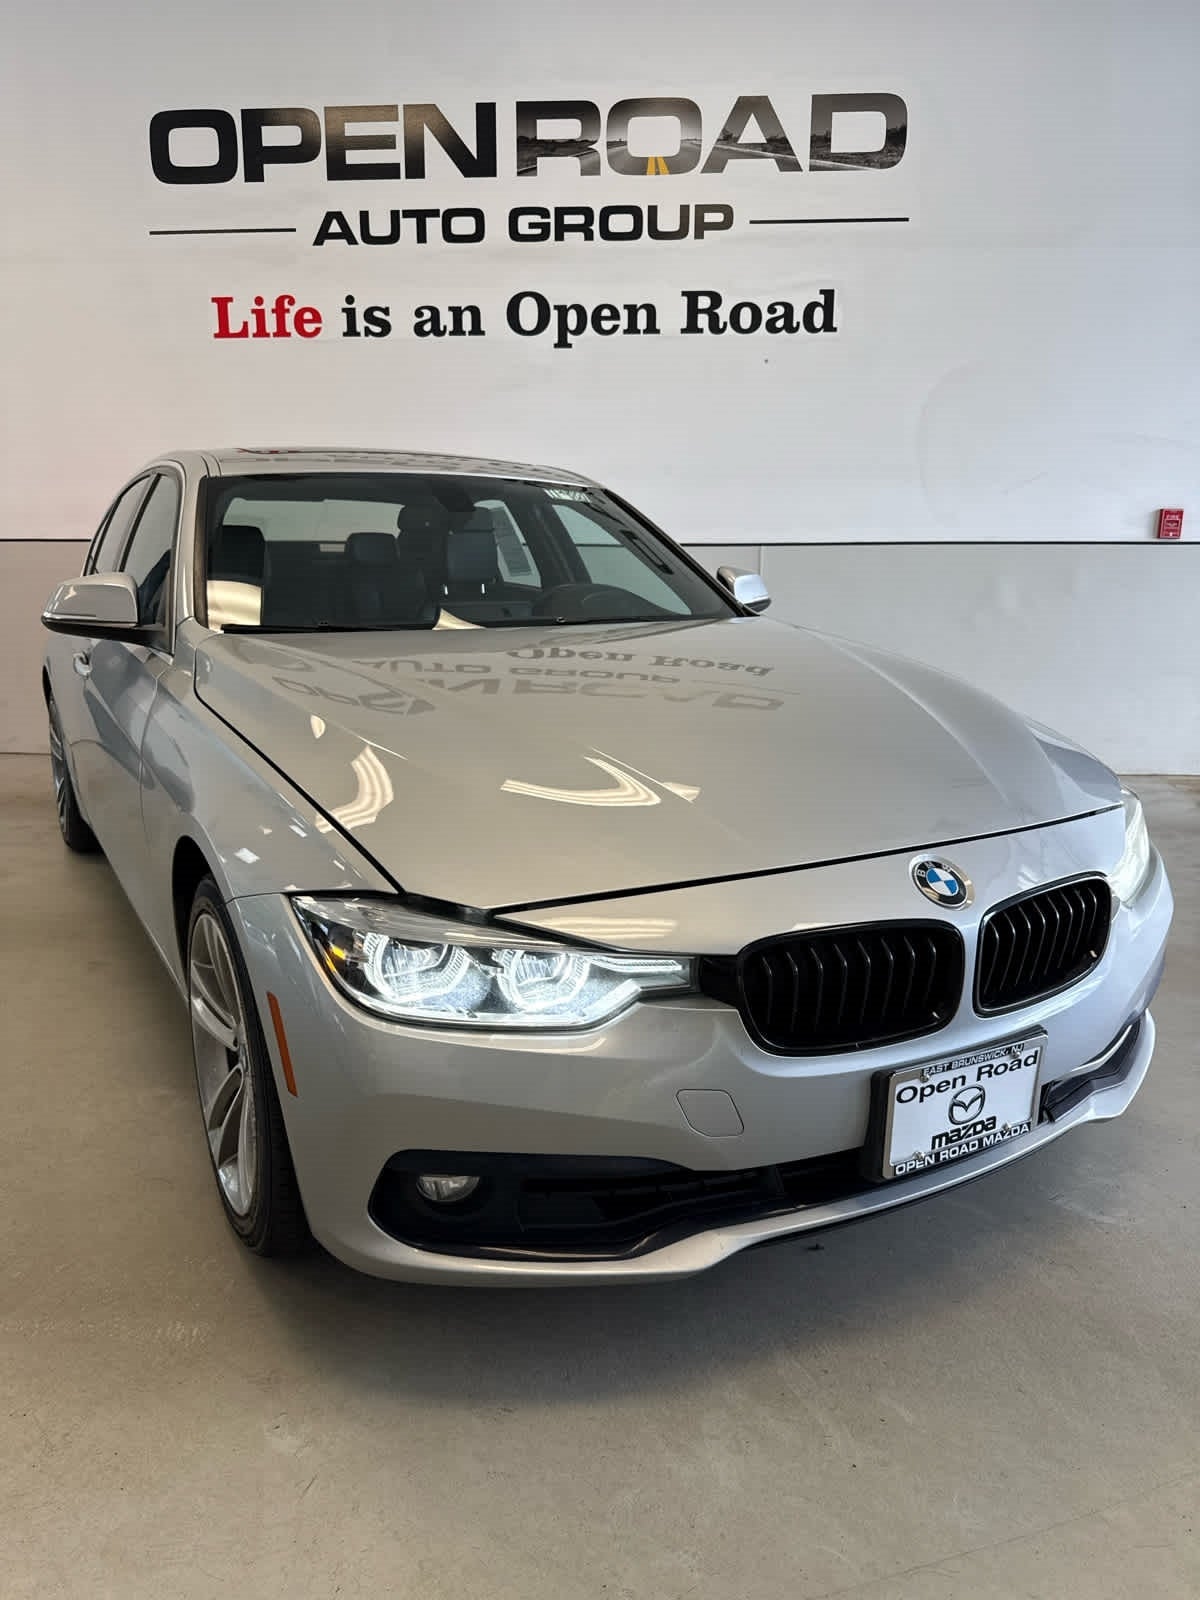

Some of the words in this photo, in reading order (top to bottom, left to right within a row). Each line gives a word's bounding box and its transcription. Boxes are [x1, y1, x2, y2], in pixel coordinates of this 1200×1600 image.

[149, 102, 497, 184] OPEN
[516, 93, 907, 176] ROAD
[313, 208, 485, 246] AUTO
[508, 204, 733, 242] GROUP
[212, 295, 322, 338] Life
[341, 295, 392, 337] is
[414, 305, 485, 337] an
[506, 291, 660, 348] Open
[680, 289, 837, 335] Road
[896, 1074, 967, 1104] Open
[976, 1050, 1039, 1083] Road
[895, 1154, 936, 1176] OPEN
[939, 1141, 980, 1162] ROAD
[982, 1124, 1030, 1148] MAZDA
[931, 1116, 997, 1151] mazda
